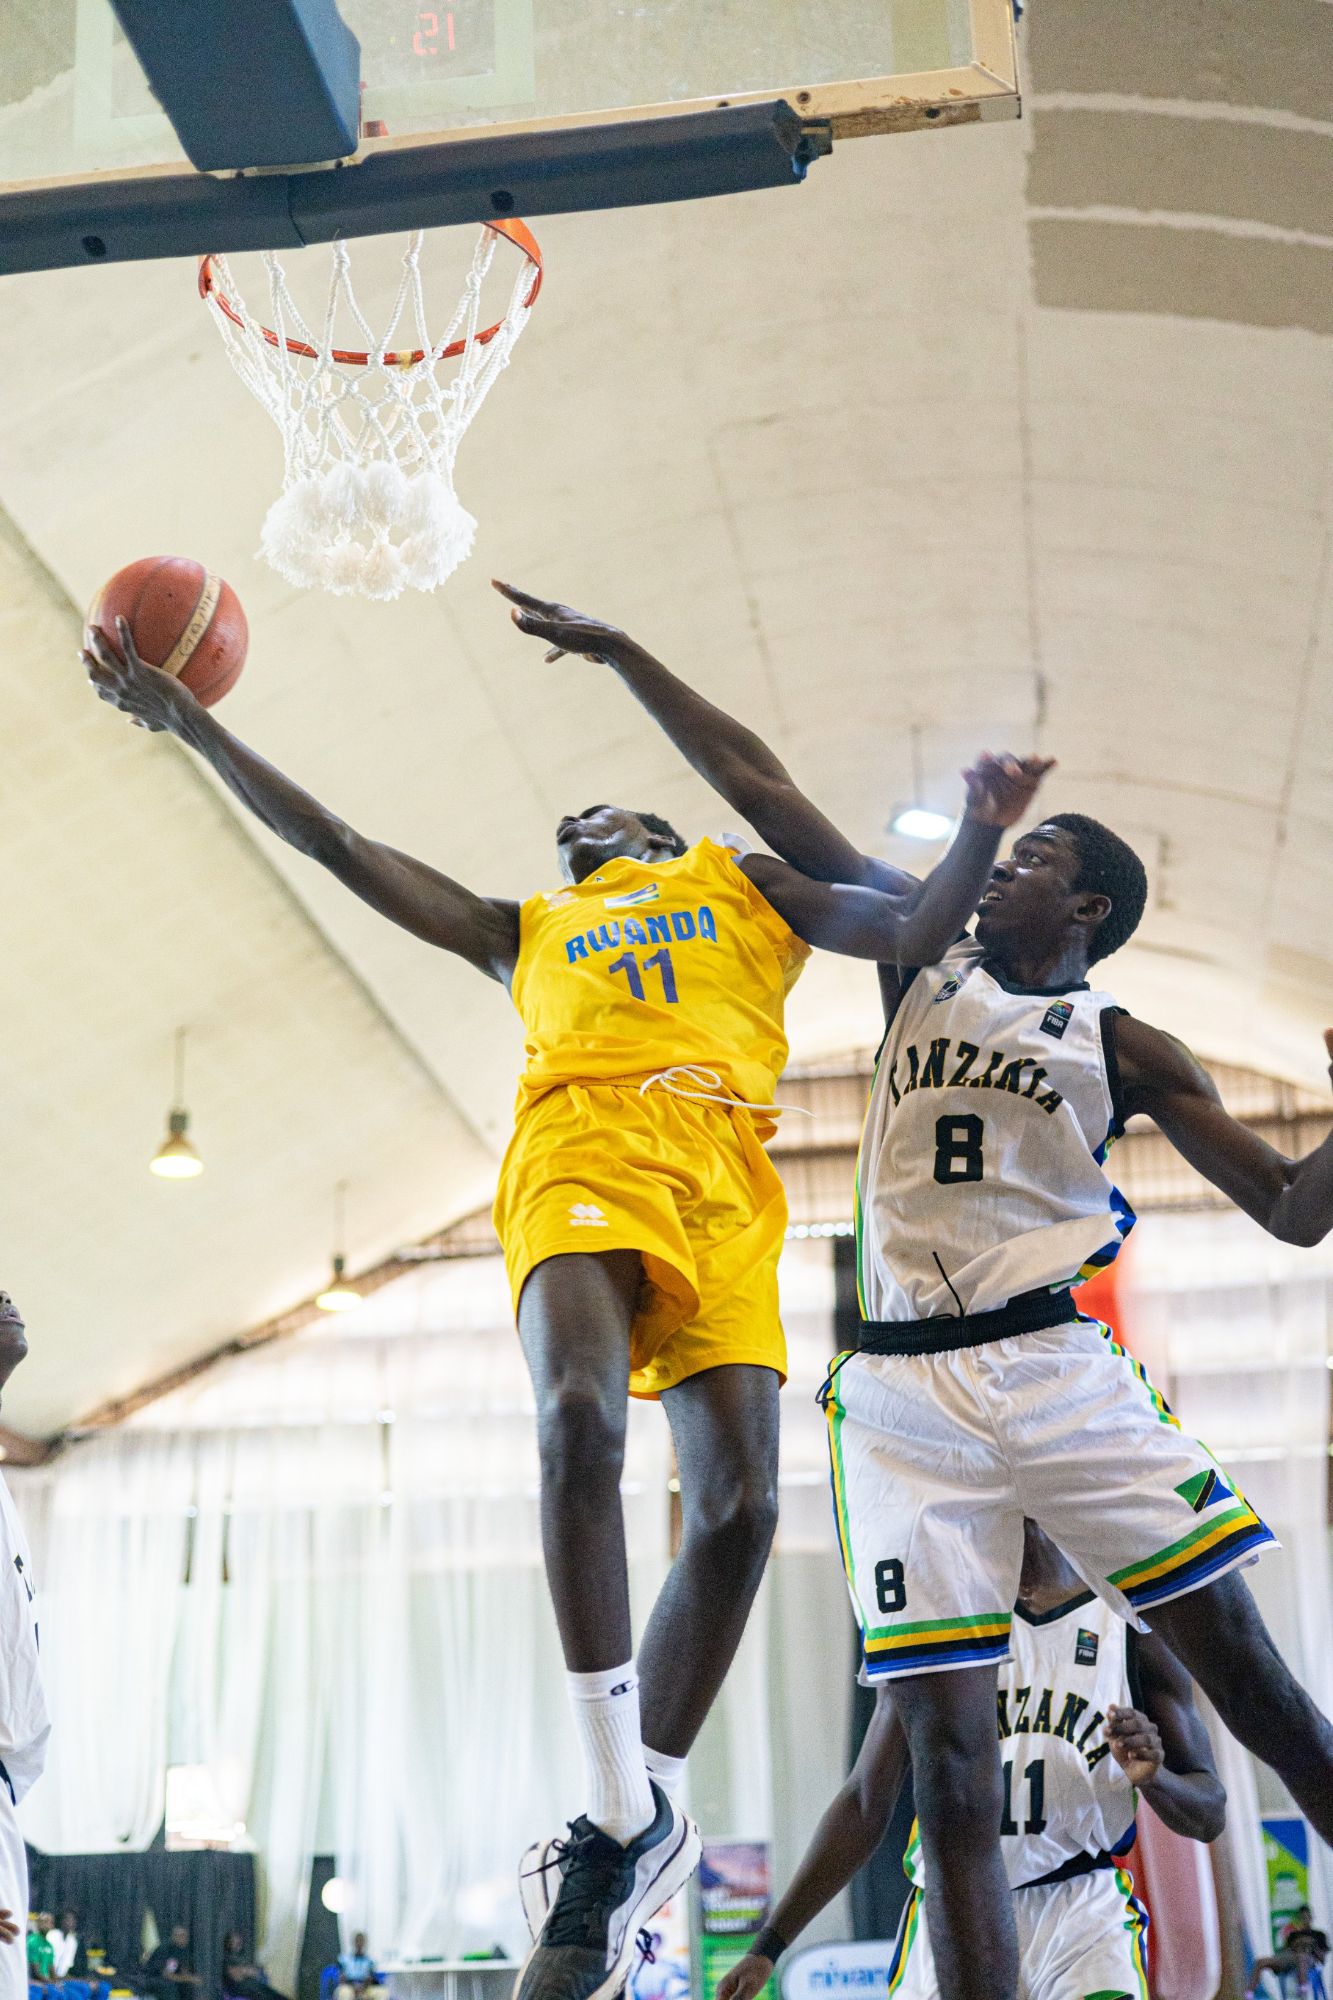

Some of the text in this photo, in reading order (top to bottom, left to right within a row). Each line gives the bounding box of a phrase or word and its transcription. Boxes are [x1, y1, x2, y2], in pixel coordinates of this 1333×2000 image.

[413, 11, 456, 56] 21
[565, 906, 718, 964] RWANDA
[608, 948, 680, 1004] 11
[933, 1113, 984, 1185] 8
[874, 1557, 908, 1614] 8
[1001, 1759, 1047, 1836] 11
